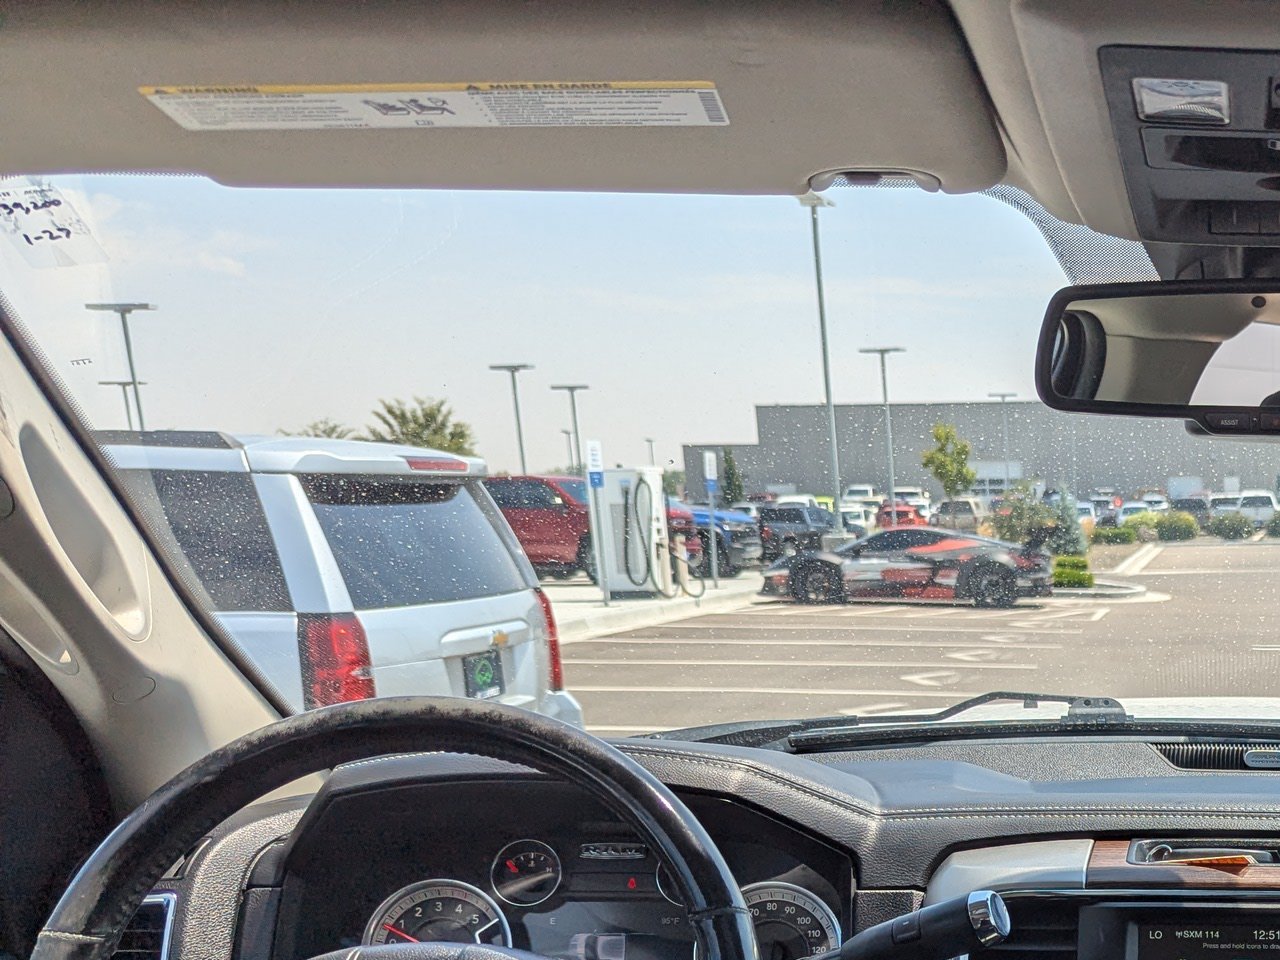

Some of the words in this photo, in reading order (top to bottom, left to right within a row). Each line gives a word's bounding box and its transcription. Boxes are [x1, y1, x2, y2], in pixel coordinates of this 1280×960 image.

[435, 901, 443, 912] 3
[455, 903, 463, 914] 4
[766, 902, 778, 911] 80
[784, 906, 796, 915] 90
[415, 907, 423, 918] 2
[399, 919, 405, 929] 1
[472, 913, 480, 925] 5
[796, 916, 812, 926] 100
[807, 929, 821, 938] 110
[1149, 930, 1163, 940] LO
[1183, 930, 1203, 939] SXM
[1205, 930, 1220, 939] 114
[1253, 930, 1280, 940] 12:51
[811, 946, 827, 954] 120
[1232, 942, 1245, 950] hold
